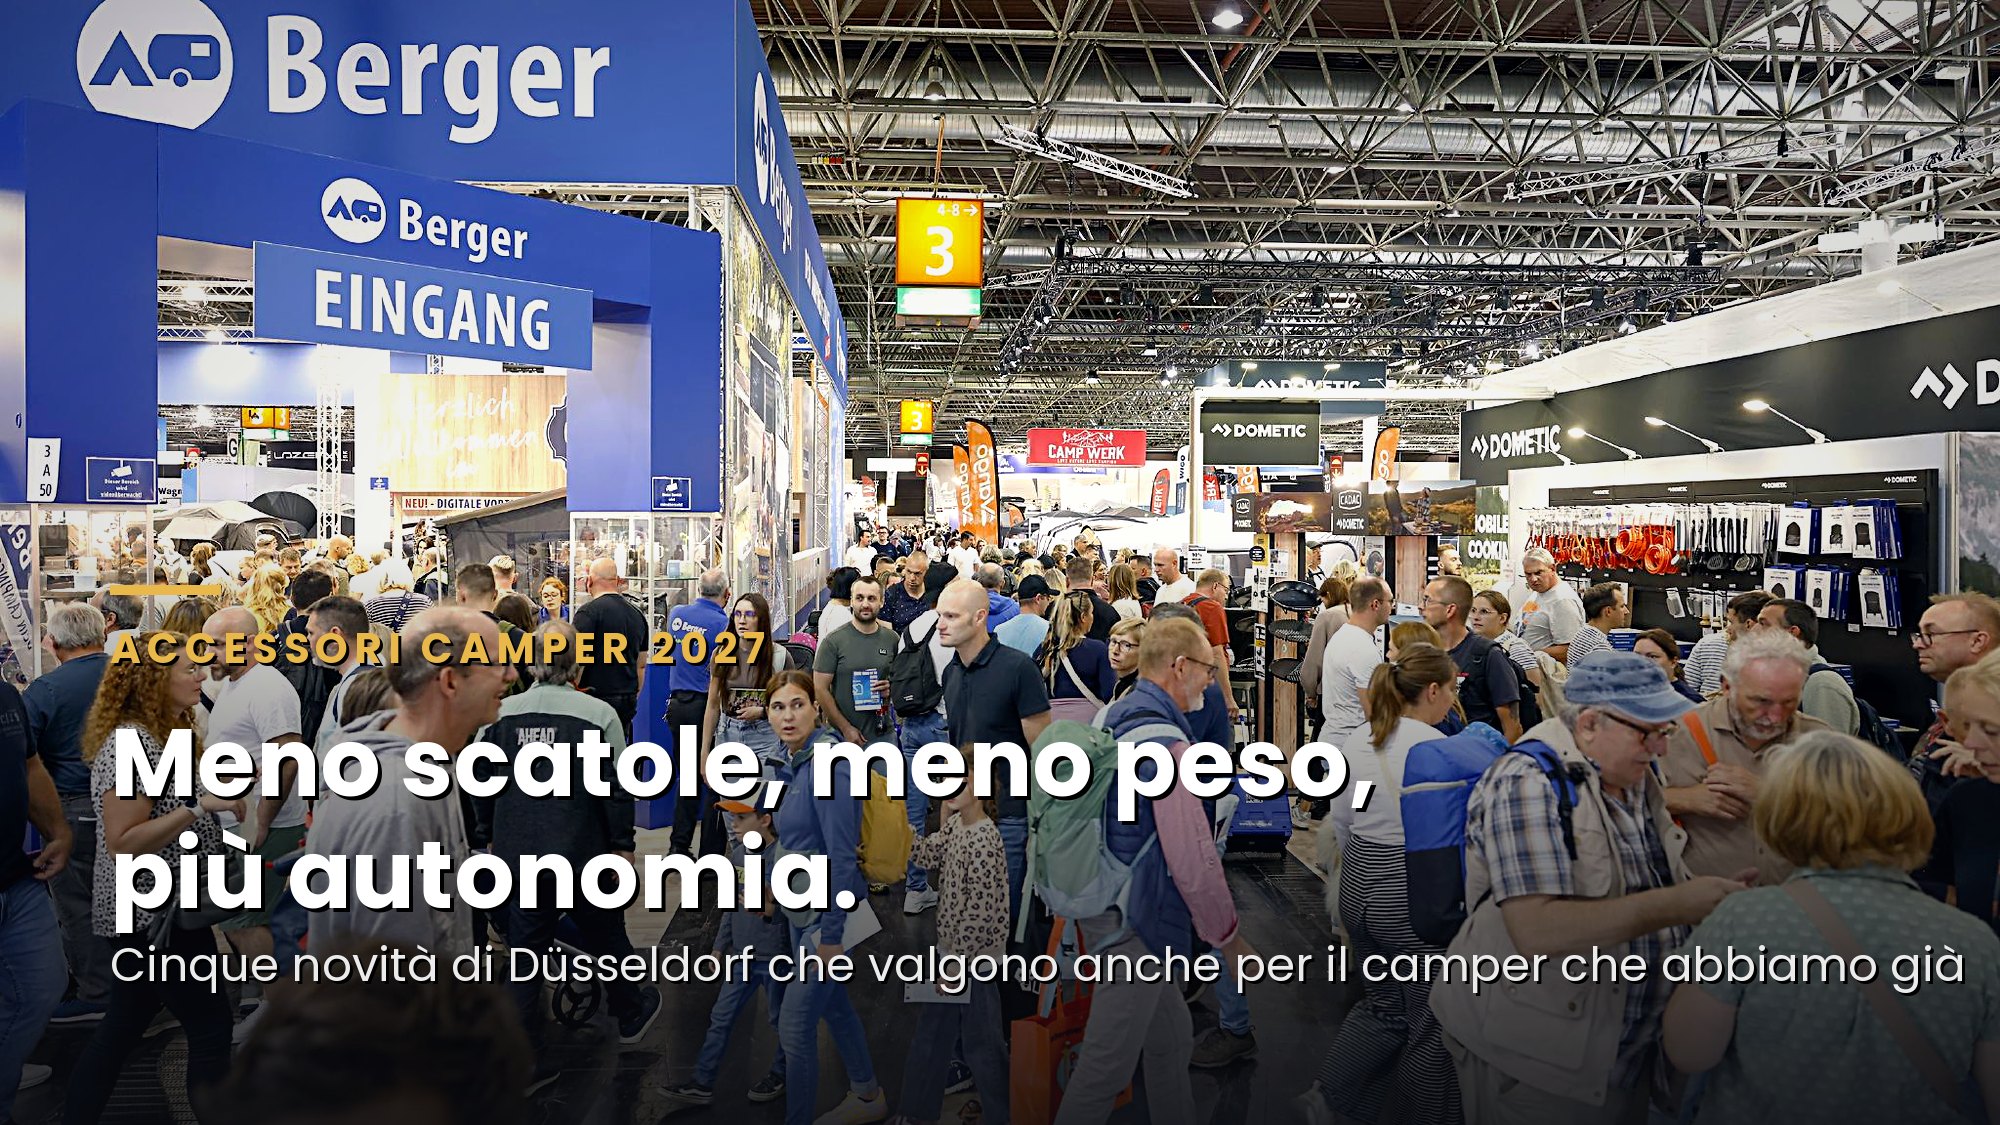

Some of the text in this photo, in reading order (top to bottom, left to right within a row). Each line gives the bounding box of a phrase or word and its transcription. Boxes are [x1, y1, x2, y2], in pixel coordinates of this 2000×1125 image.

[267, 14, 611, 144] Berger
[769, 125, 793, 254] Berger
[400, 198, 529, 263] Berger
[925, 225, 955, 277] 3
[314, 268, 551, 351] EINGANG
[911, 411, 923, 431] 3
[1233, 424, 1307, 438] DOMETIC
[44, 444, 51, 458] 3
[1048, 444, 1126, 460] CAMP WERK
[1490, 424, 1561, 460] DOMETIC
[42, 463, 51, 477] A
[39, 483, 52, 497] 50
[405, 498, 428, 509] NEU!
[437, 498, 482, 509] DIGITALE
[1475, 514, 1508, 534] OBILE
[517, 727, 556, 746] AHEAD
